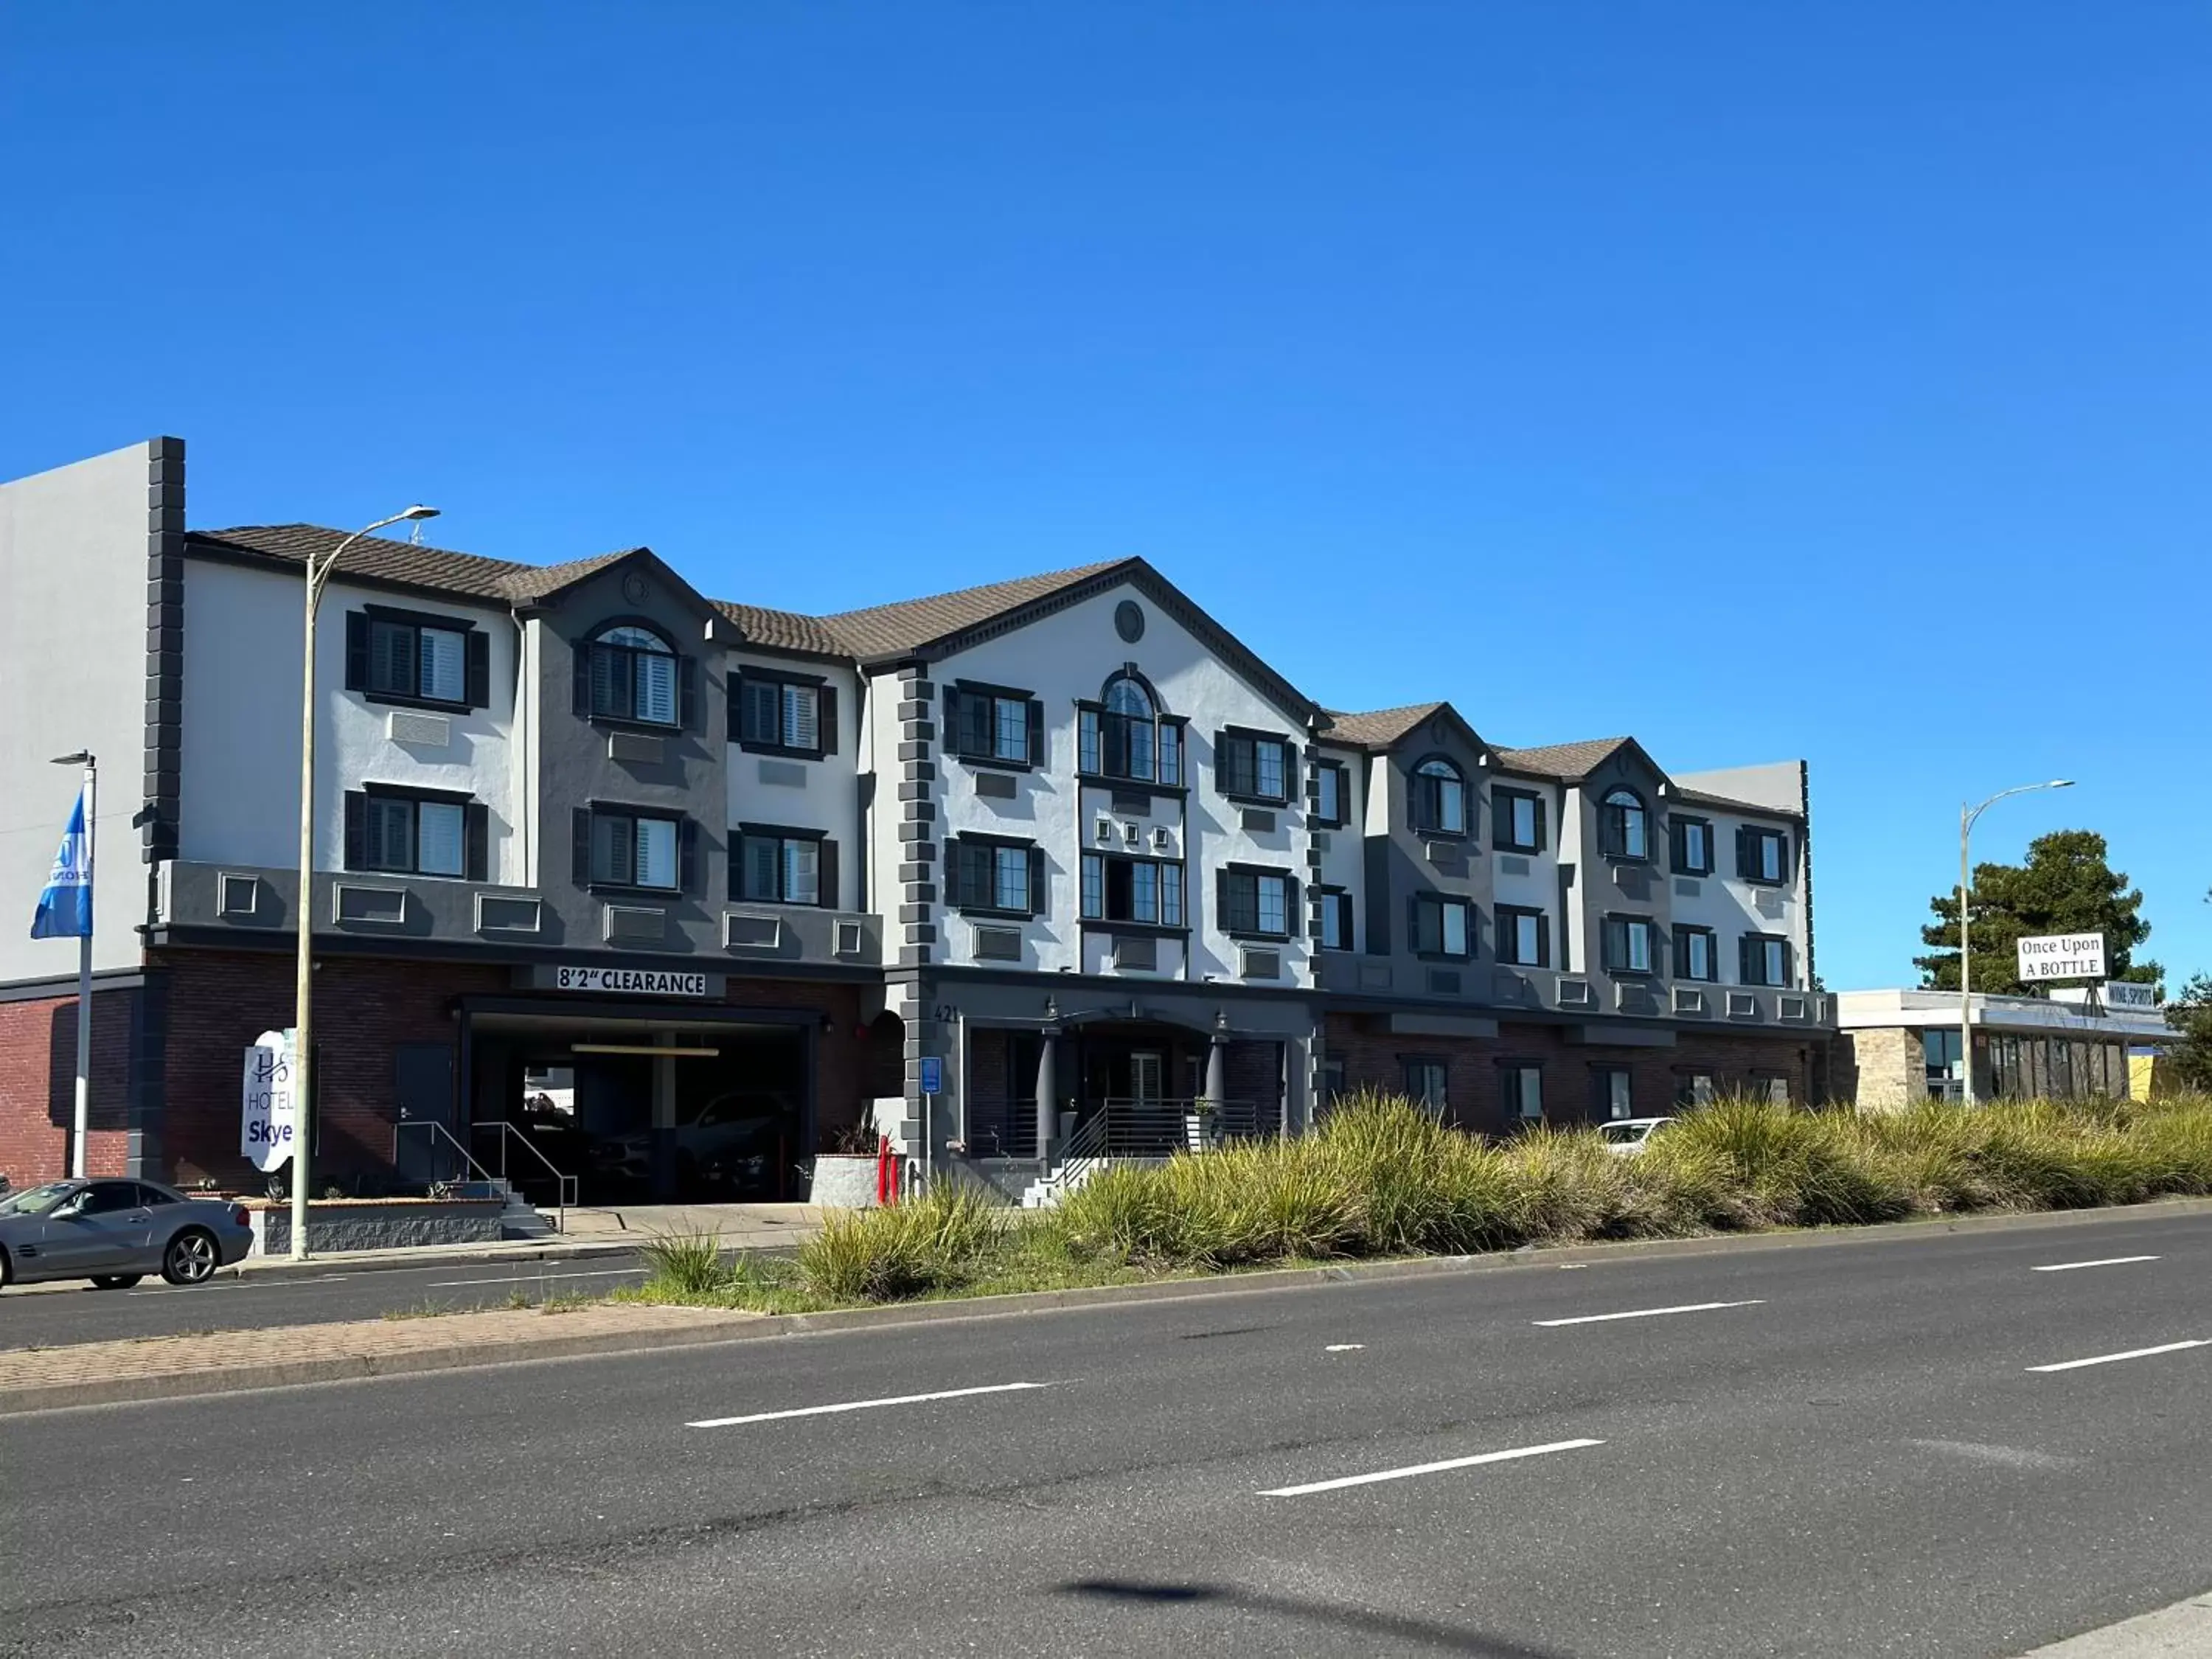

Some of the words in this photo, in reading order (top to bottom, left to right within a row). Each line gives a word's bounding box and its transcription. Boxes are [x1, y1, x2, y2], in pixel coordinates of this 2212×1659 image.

[2023, 942, 2057, 954] Once
[2062, 939, 2100, 956] Upon
[2026, 963, 2036, 976] A
[2041, 959, 2098, 975] BOTTLE
[602, 970, 703, 993] CLEARANCE
[935, 1005, 958, 1023] 421
[248, 1092, 294, 1110] HOTEL
[248, 1119, 293, 1147] Skye
